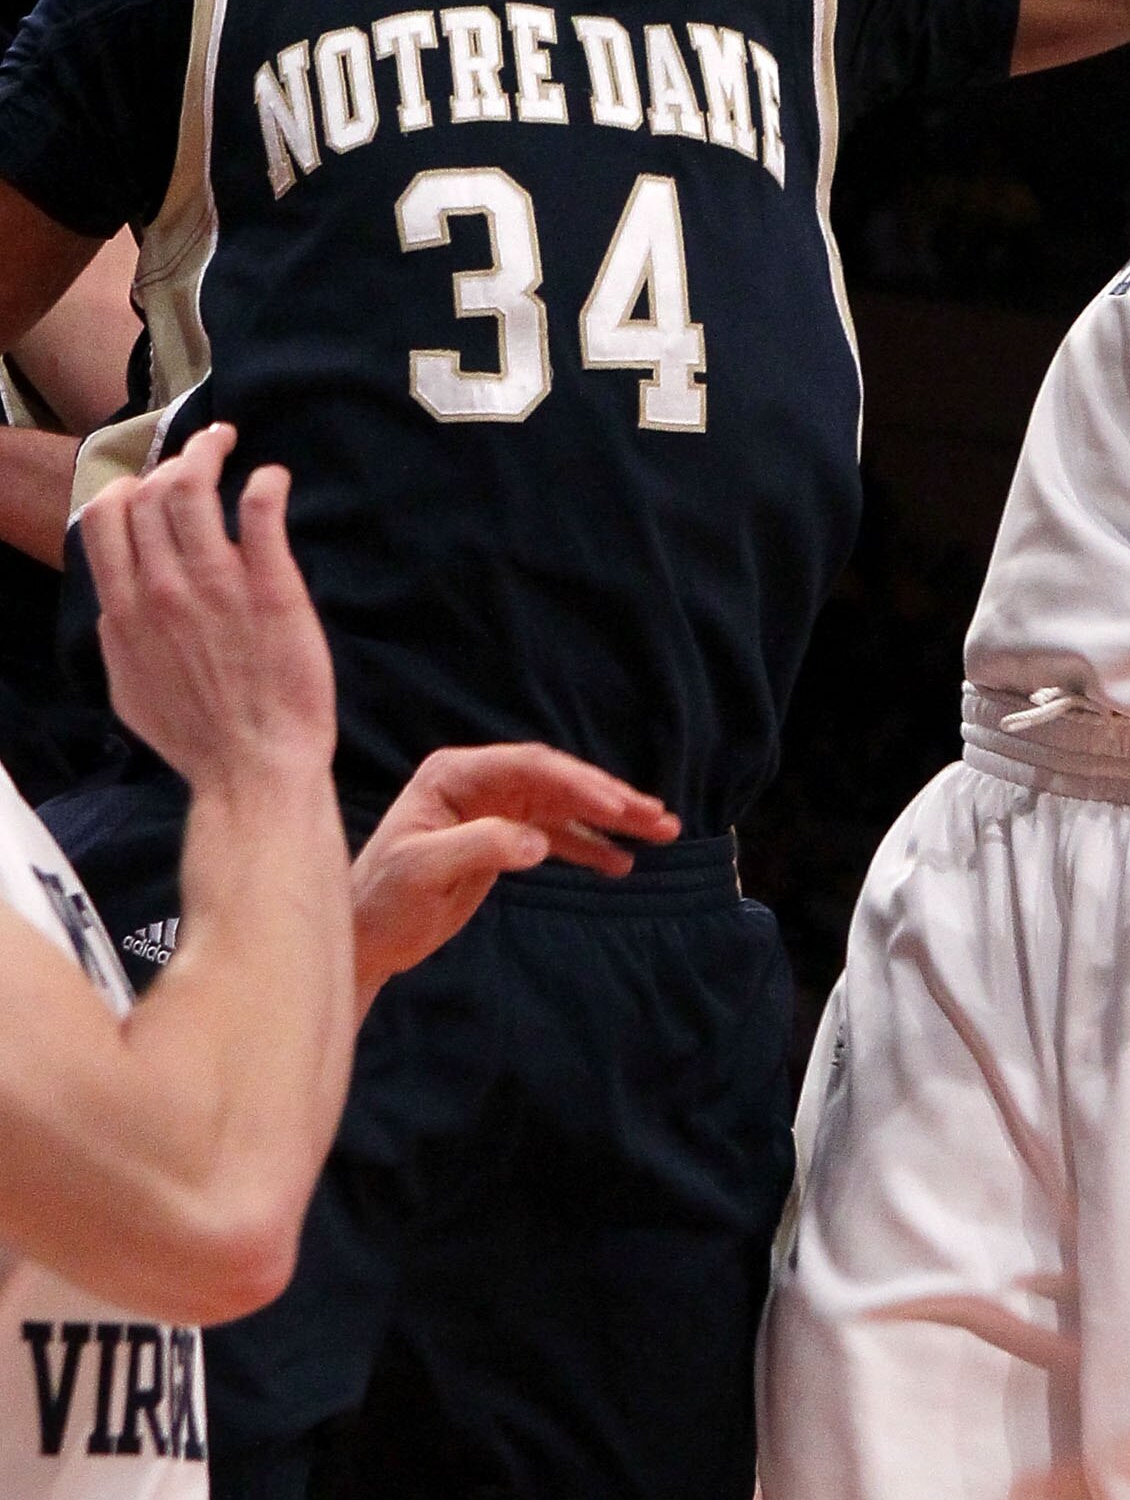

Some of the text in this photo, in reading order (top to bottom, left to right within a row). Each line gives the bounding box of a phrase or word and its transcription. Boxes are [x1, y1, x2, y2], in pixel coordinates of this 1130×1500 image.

[253, 2, 786, 200] NOTRE DAME
[394, 167, 706, 433] 34
[123, 935, 172, 964] adida
